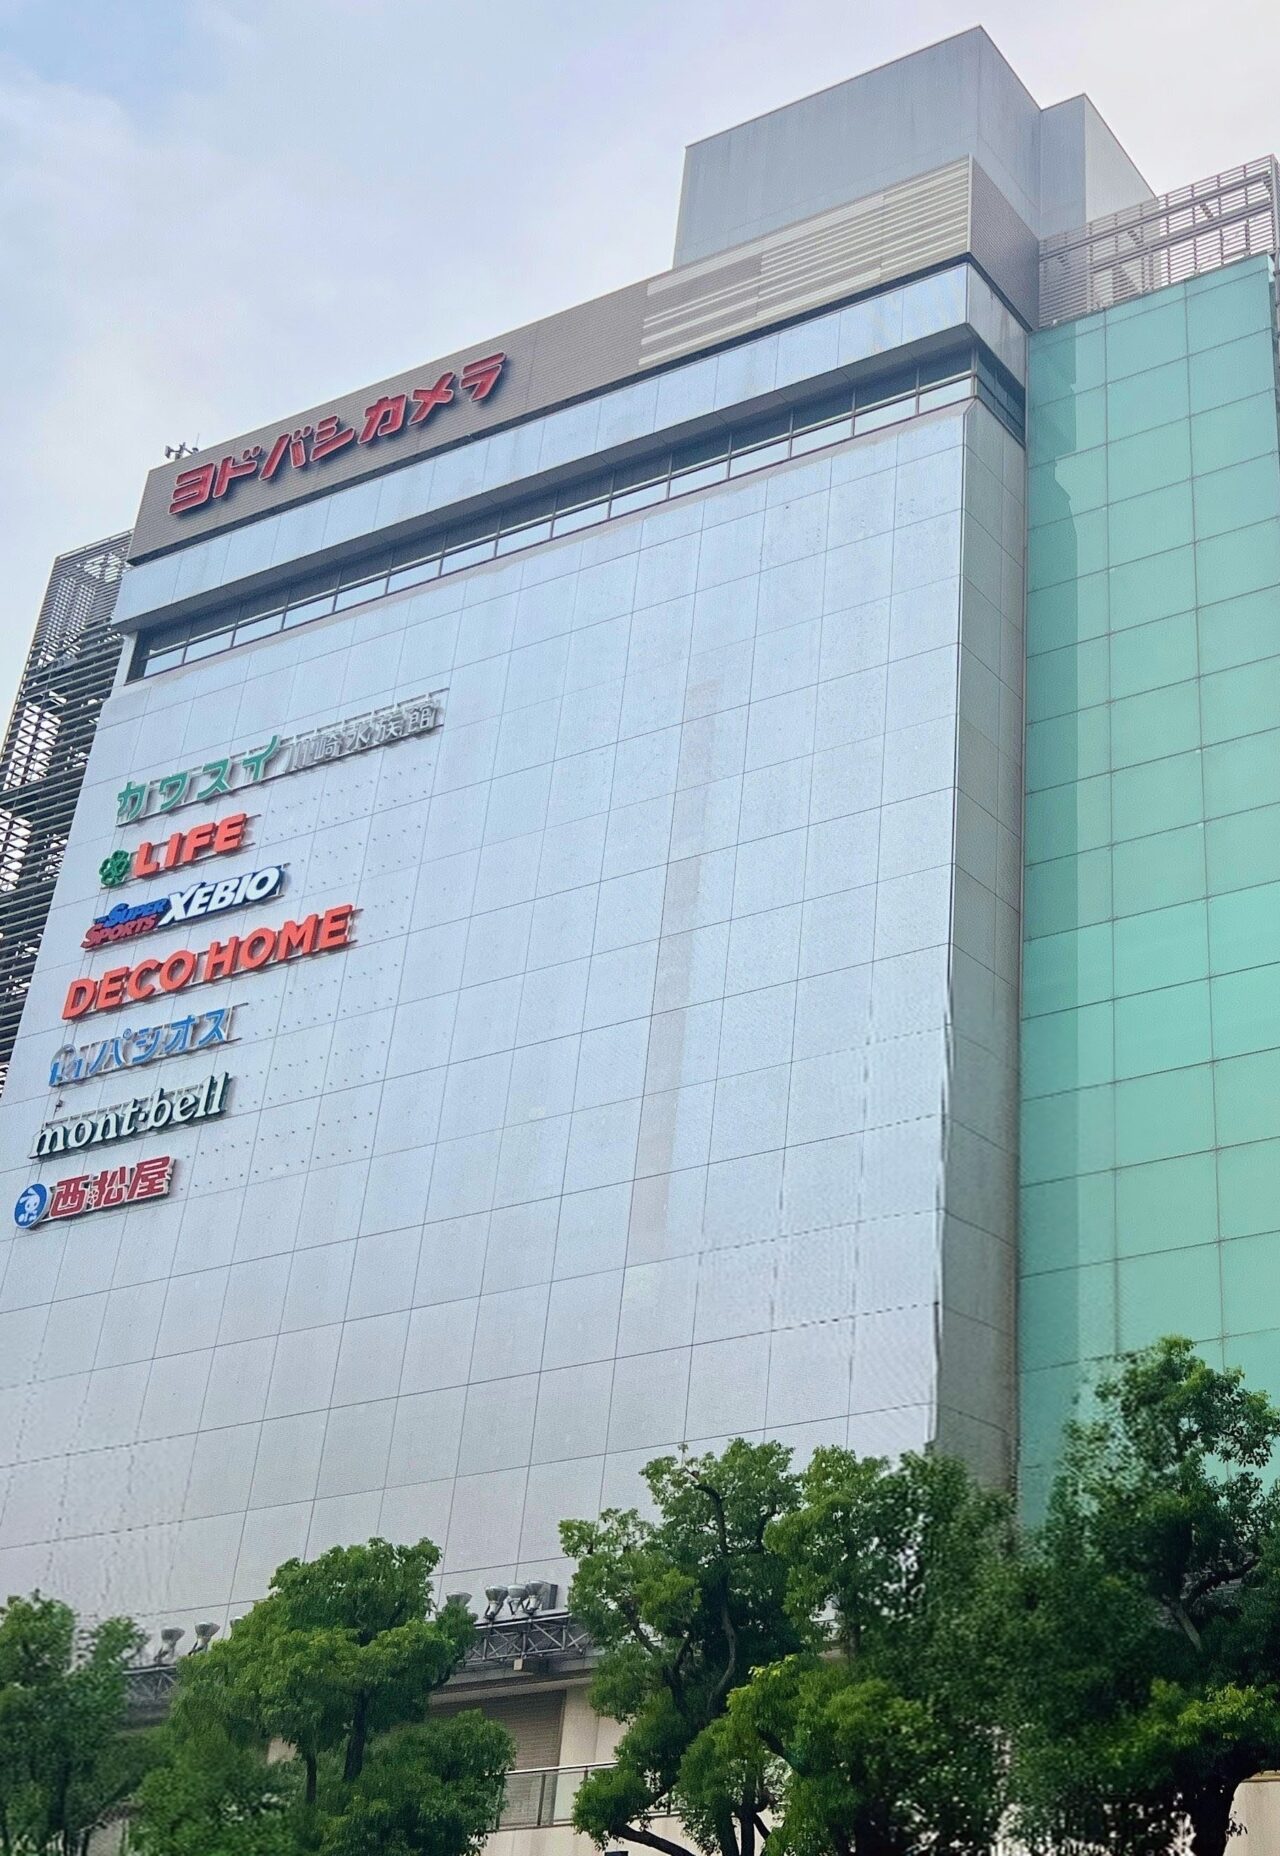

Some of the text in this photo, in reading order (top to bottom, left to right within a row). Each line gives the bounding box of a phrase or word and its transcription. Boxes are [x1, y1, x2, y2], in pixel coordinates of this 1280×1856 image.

[168, 351, 507, 515] ヨドバシカメラ
[117, 702, 438, 823] カワスイ 川崎水族館
[134, 812, 249, 878] LIFE
[103, 897, 170, 928] SUPER
[157, 866, 281, 927] XEBIO
[61, 904, 353, 1020] DECO HOME
[80, 914, 158, 949] SPORTS
[88, 1007, 229, 1076] パシオス
[49, 1155, 173, 1218] 西松屋
